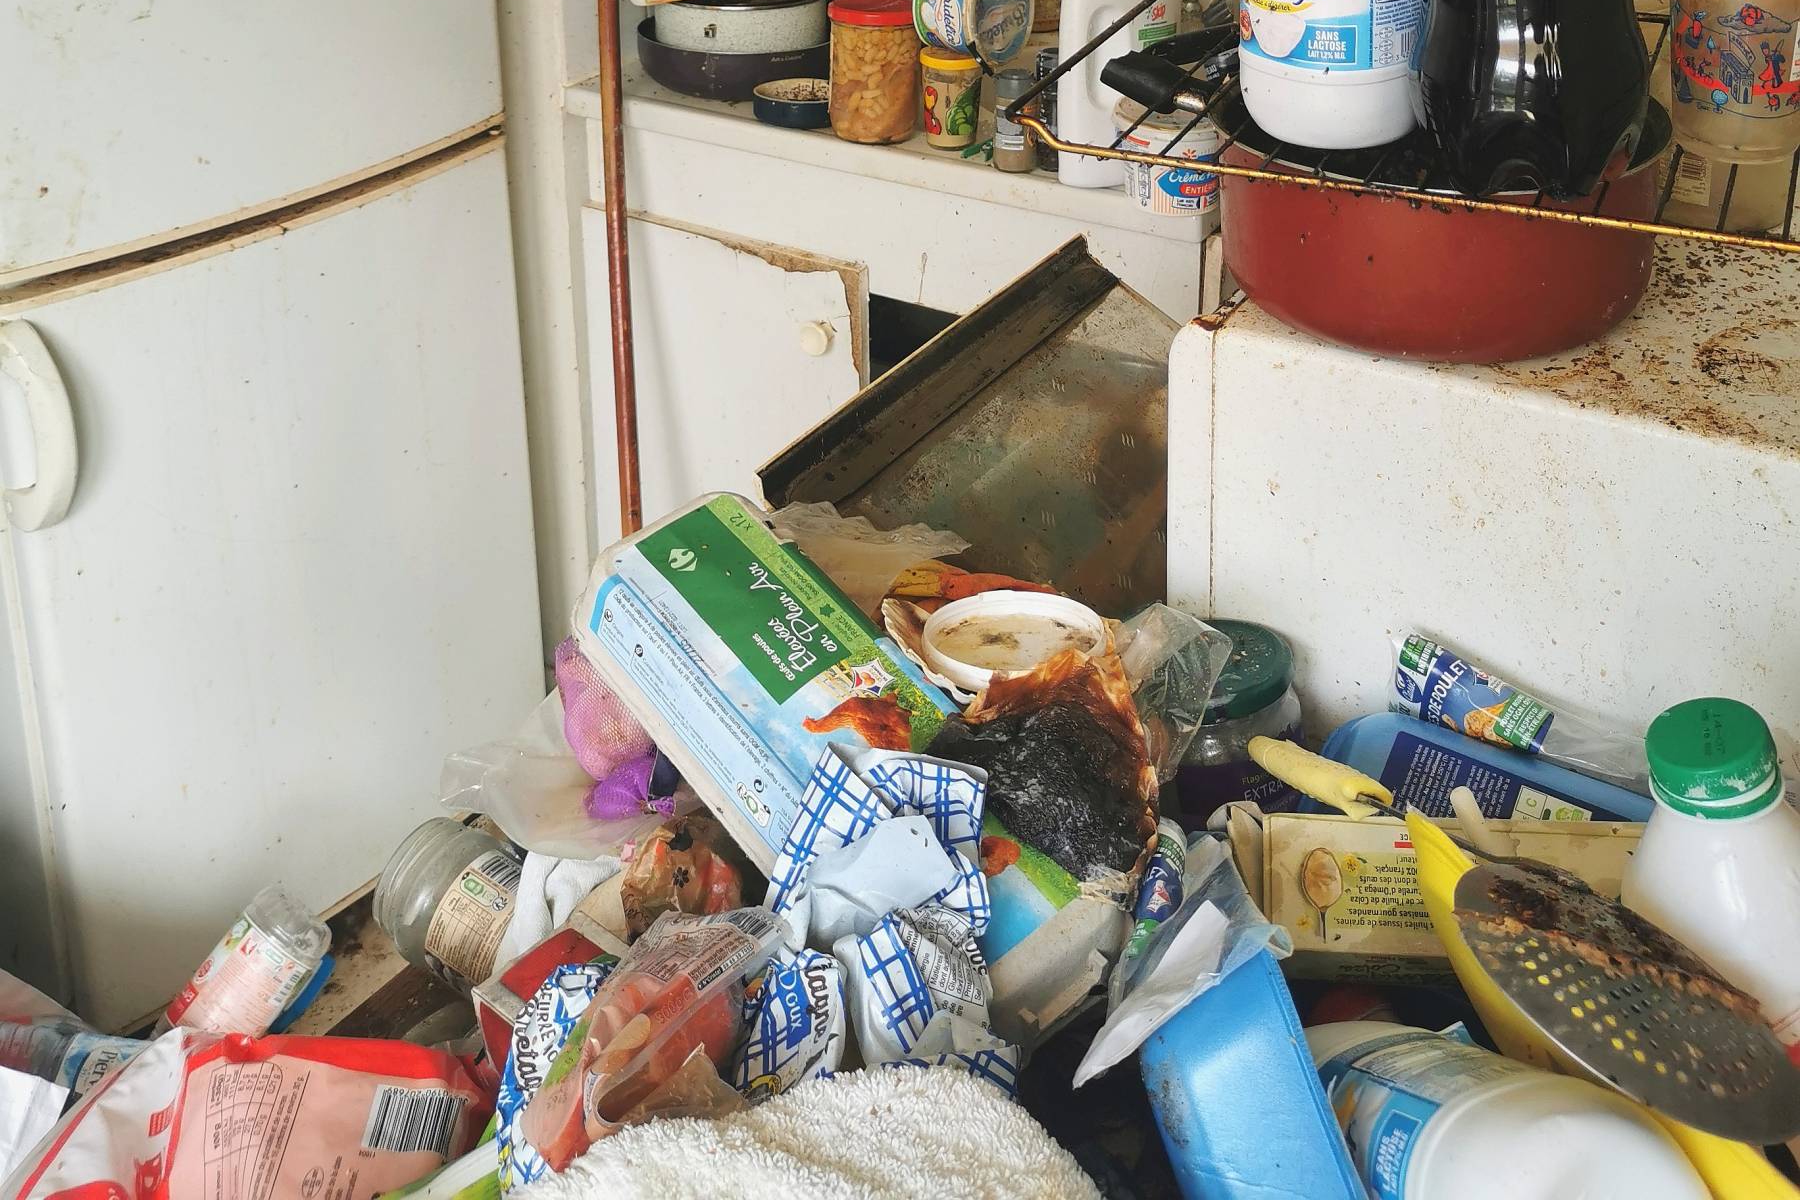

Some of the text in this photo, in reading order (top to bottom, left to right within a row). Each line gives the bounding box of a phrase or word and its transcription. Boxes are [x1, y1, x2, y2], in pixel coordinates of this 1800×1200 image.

[1315, 30, 1339, 41] SANS
[1308, 40, 1347, 51] LACTOSE
[1308, 50, 1320, 59] LAIT
[749, 562, 838, 653] en Plein Air
[752, 632, 772, 656] poules
[770, 652, 782, 664] de
[1429, 659, 1468, 717] DE POULET
[1502, 719, 1516, 737] SANS
[1375, 864, 1404, 875] français
[1359, 875, 1376, 883] œufs
[1379, 876, 1391, 884] des
[1350, 896, 1368, 904] Colza
[1381, 897, 1403, 905] l'huile
[1346, 908, 1396, 917] gourmandes.
[1333, 917, 1364, 926] graines,
[1367, 919, 1376, 927] de
[1378, 920, 1402, 928] issues
[1404, 921, 1427, 929] huiles
